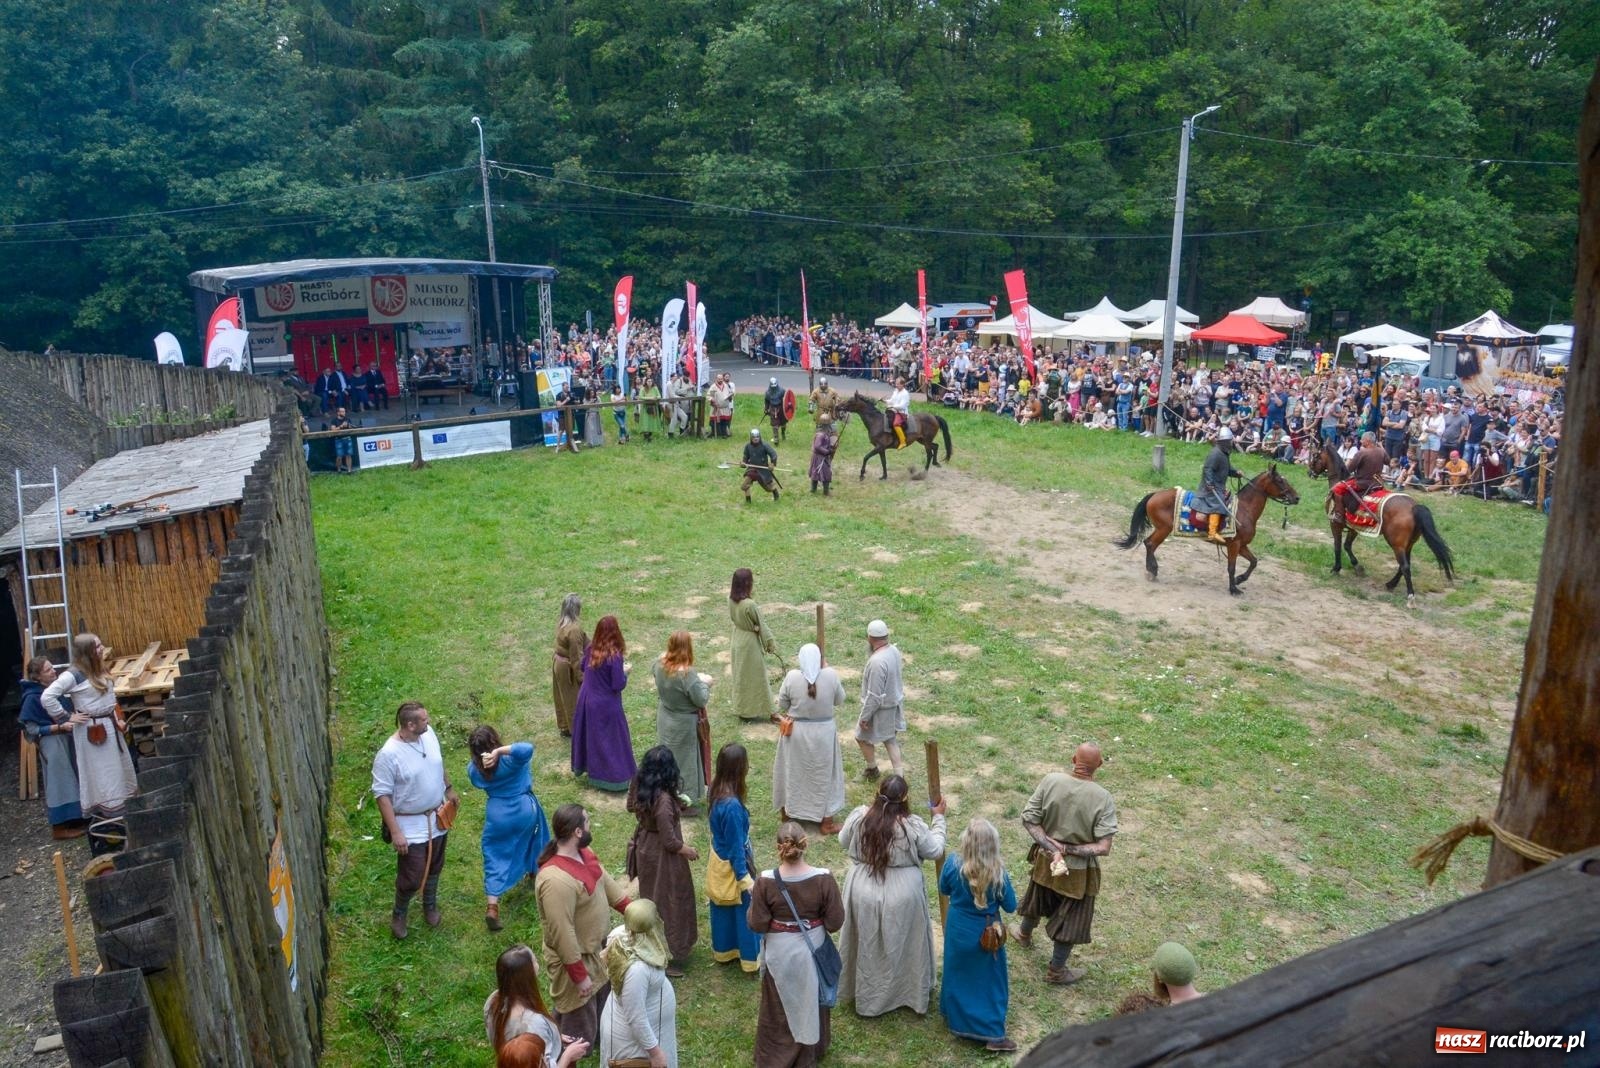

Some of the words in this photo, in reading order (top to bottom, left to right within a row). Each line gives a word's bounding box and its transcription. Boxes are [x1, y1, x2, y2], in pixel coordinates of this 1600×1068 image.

[301, 281, 333, 290] MIASTO
[415, 284, 459, 294] MIASTO
[302, 288, 361, 303] Racibórz
[409, 295, 465, 307] RACIBÓRZ
[365, 442, 377, 451] cz
[379, 440, 390, 450] pl
